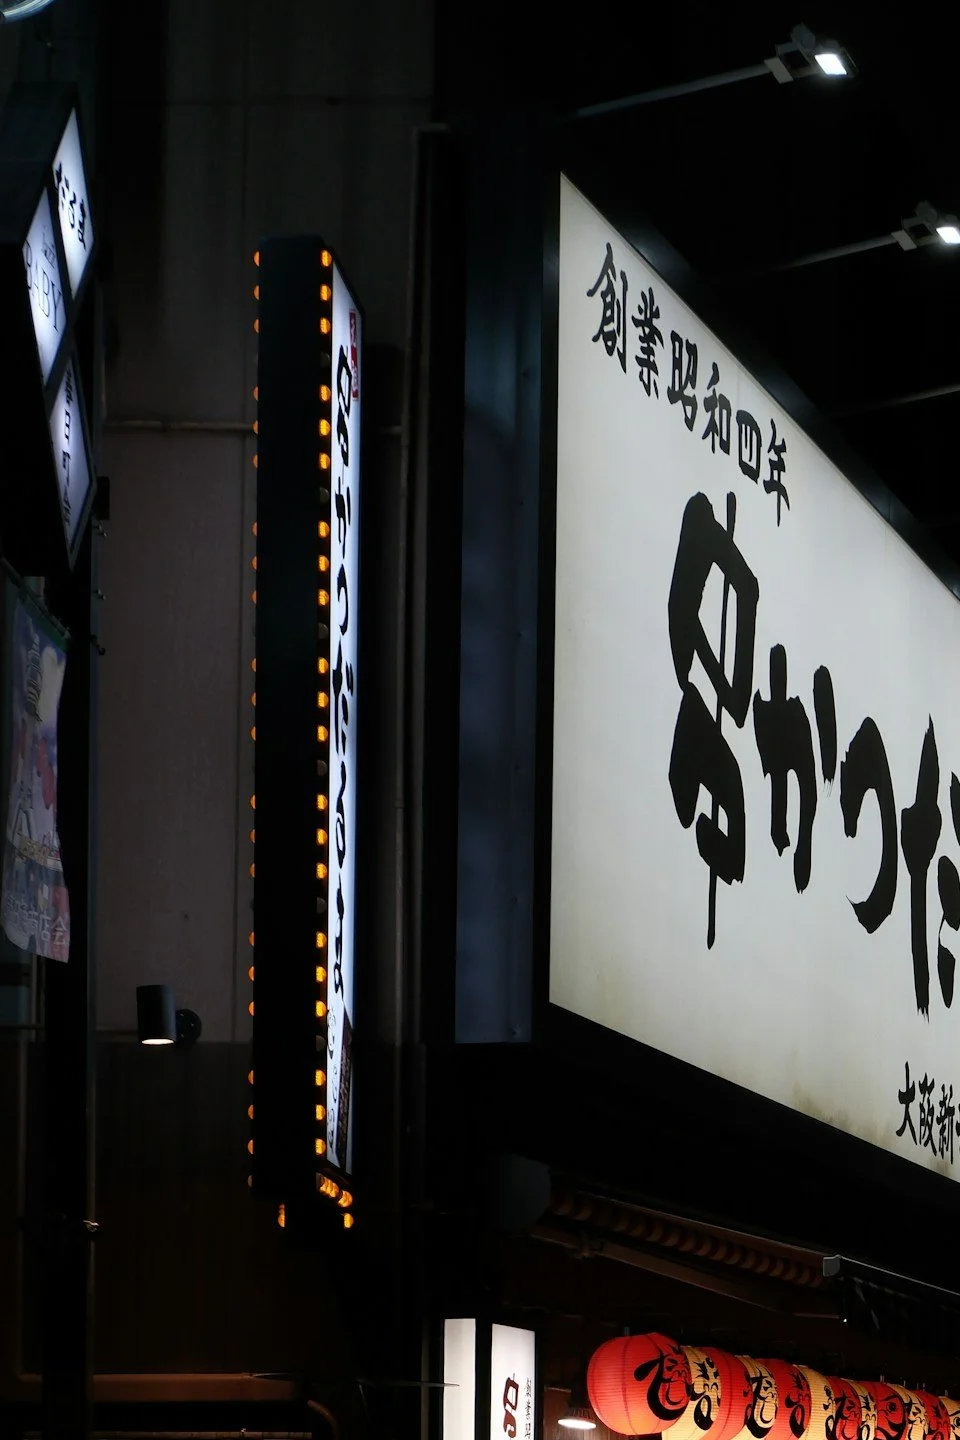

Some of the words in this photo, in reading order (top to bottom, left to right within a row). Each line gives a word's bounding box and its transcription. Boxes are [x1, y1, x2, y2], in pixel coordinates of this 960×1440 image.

[587, 242, 790, 527] 創業昭和四年
[331, 344, 354, 1000] 串かつだるま
